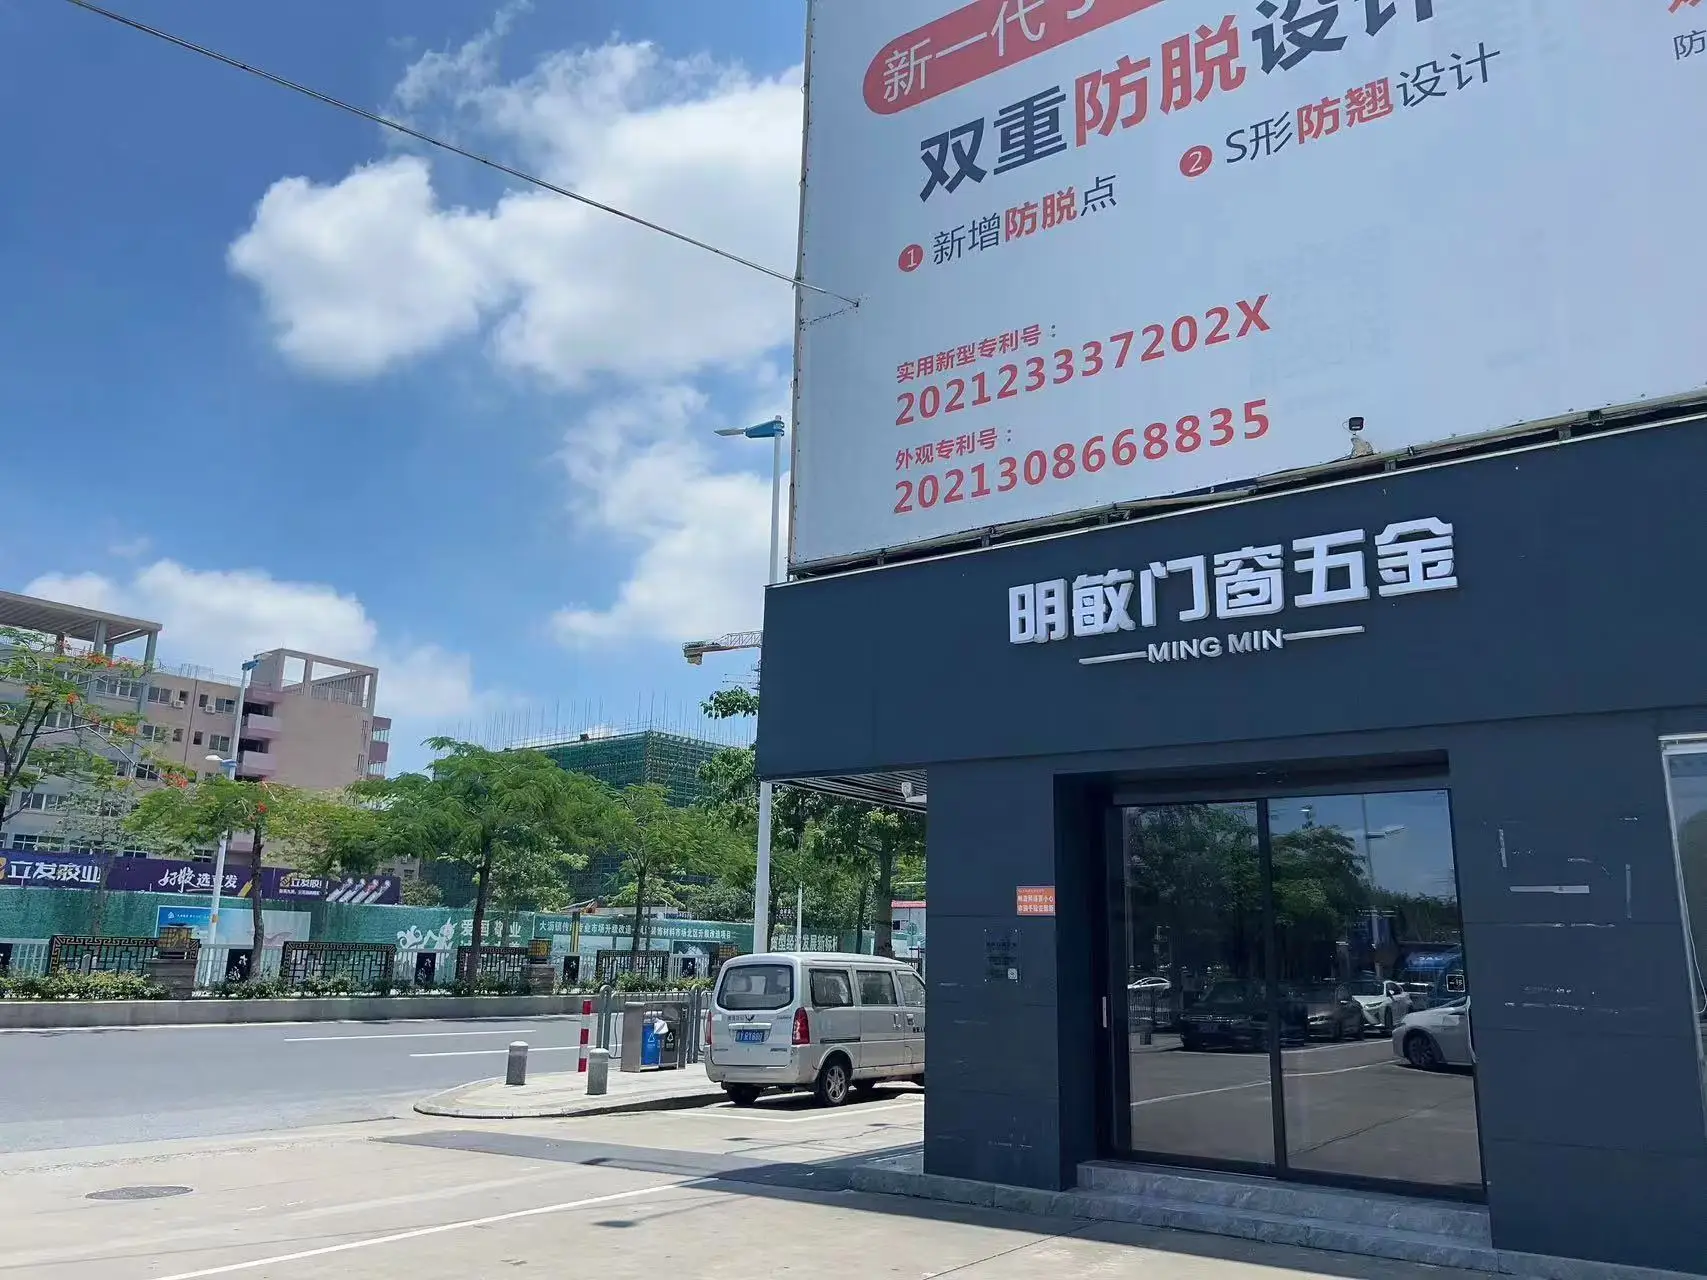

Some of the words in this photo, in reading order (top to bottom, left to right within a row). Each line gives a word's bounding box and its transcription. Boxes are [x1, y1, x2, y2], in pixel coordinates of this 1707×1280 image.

[882, 0, 1094, 102] 新一代
[1225, 42, 1502, 164] S形防翘设计
[932, 174, 1118, 265] 新增防脱点
[895, 293, 1271, 426] 202123337202X
[894, 398, 1270, 514] 2021308668835
[1008, 516, 1458, 644] 明敏门窗五金
[1148, 636, 1223, 663] MING
[1228, 628, 1284, 654] MIN
